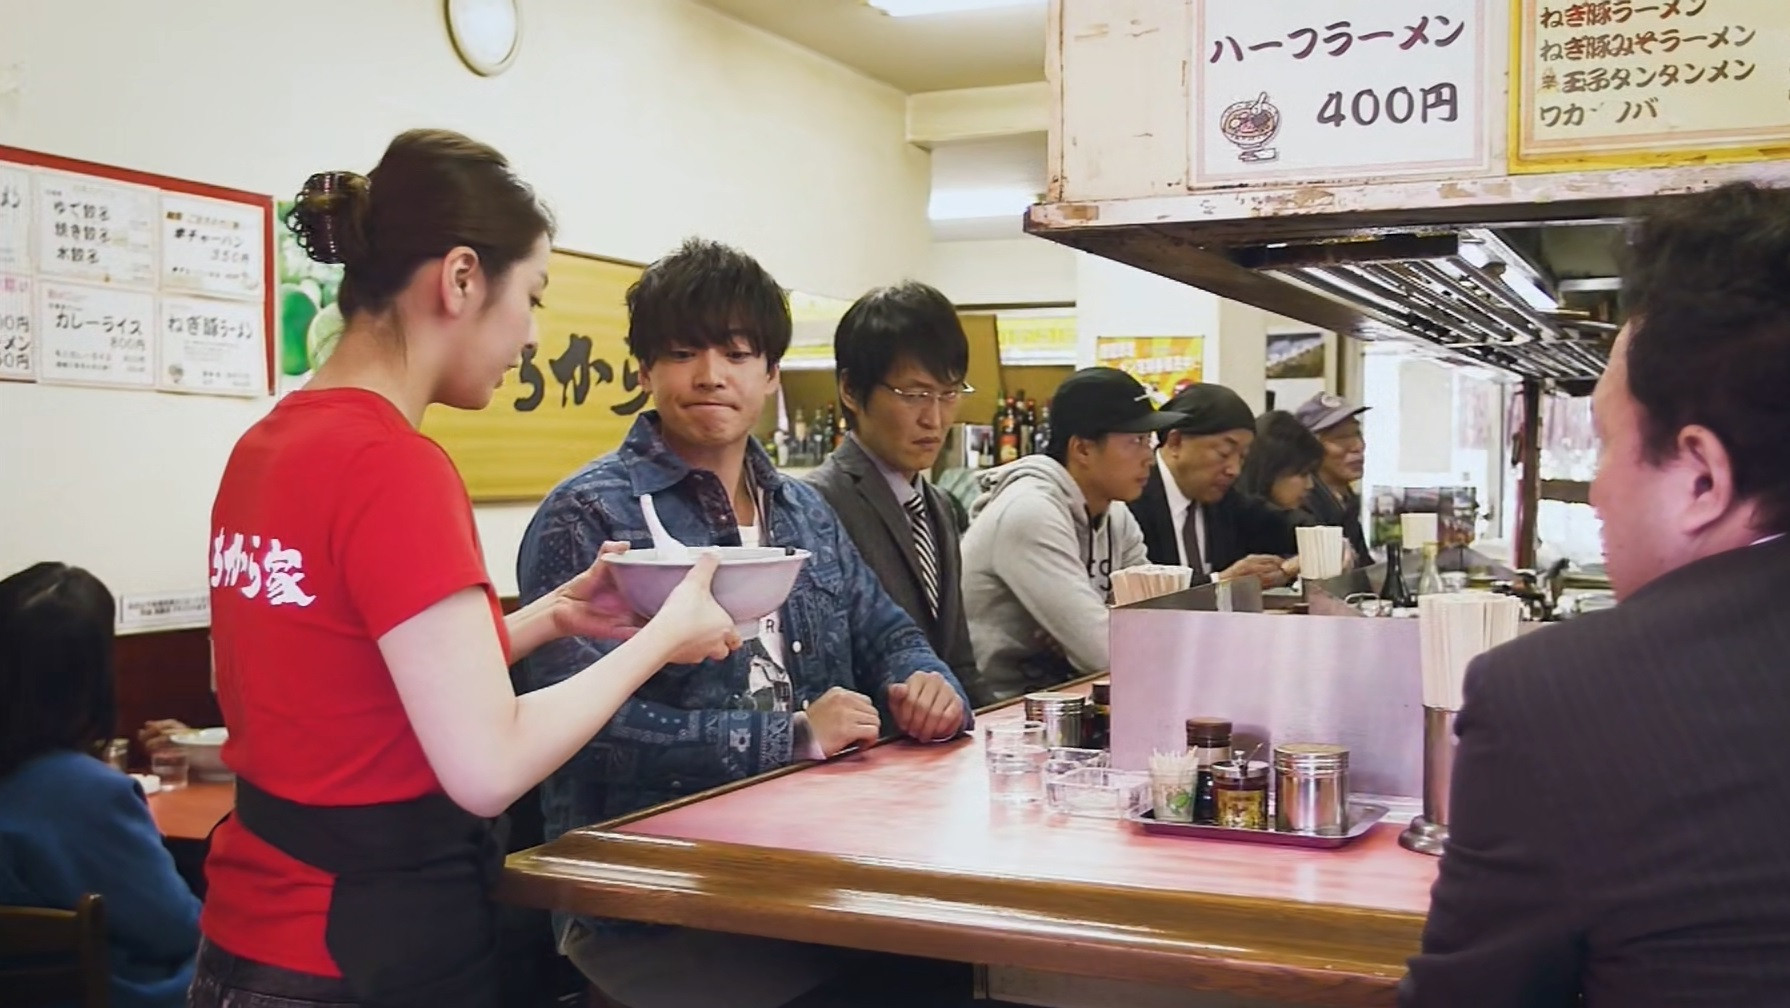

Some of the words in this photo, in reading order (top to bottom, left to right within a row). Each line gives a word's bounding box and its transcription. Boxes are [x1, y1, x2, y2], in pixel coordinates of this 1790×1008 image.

[1540, 0, 1706, 28] ねぎ豚ラーメン
[1210, 15, 1465, 64] ハーフラーメン
[1540, 25, 1756, 61] ねぎ豚みそラーメン
[1316, 82, 1459, 127] 400円
[55, 313, 143, 336] カレーライス
[0, 352, 30, 370] 0円
